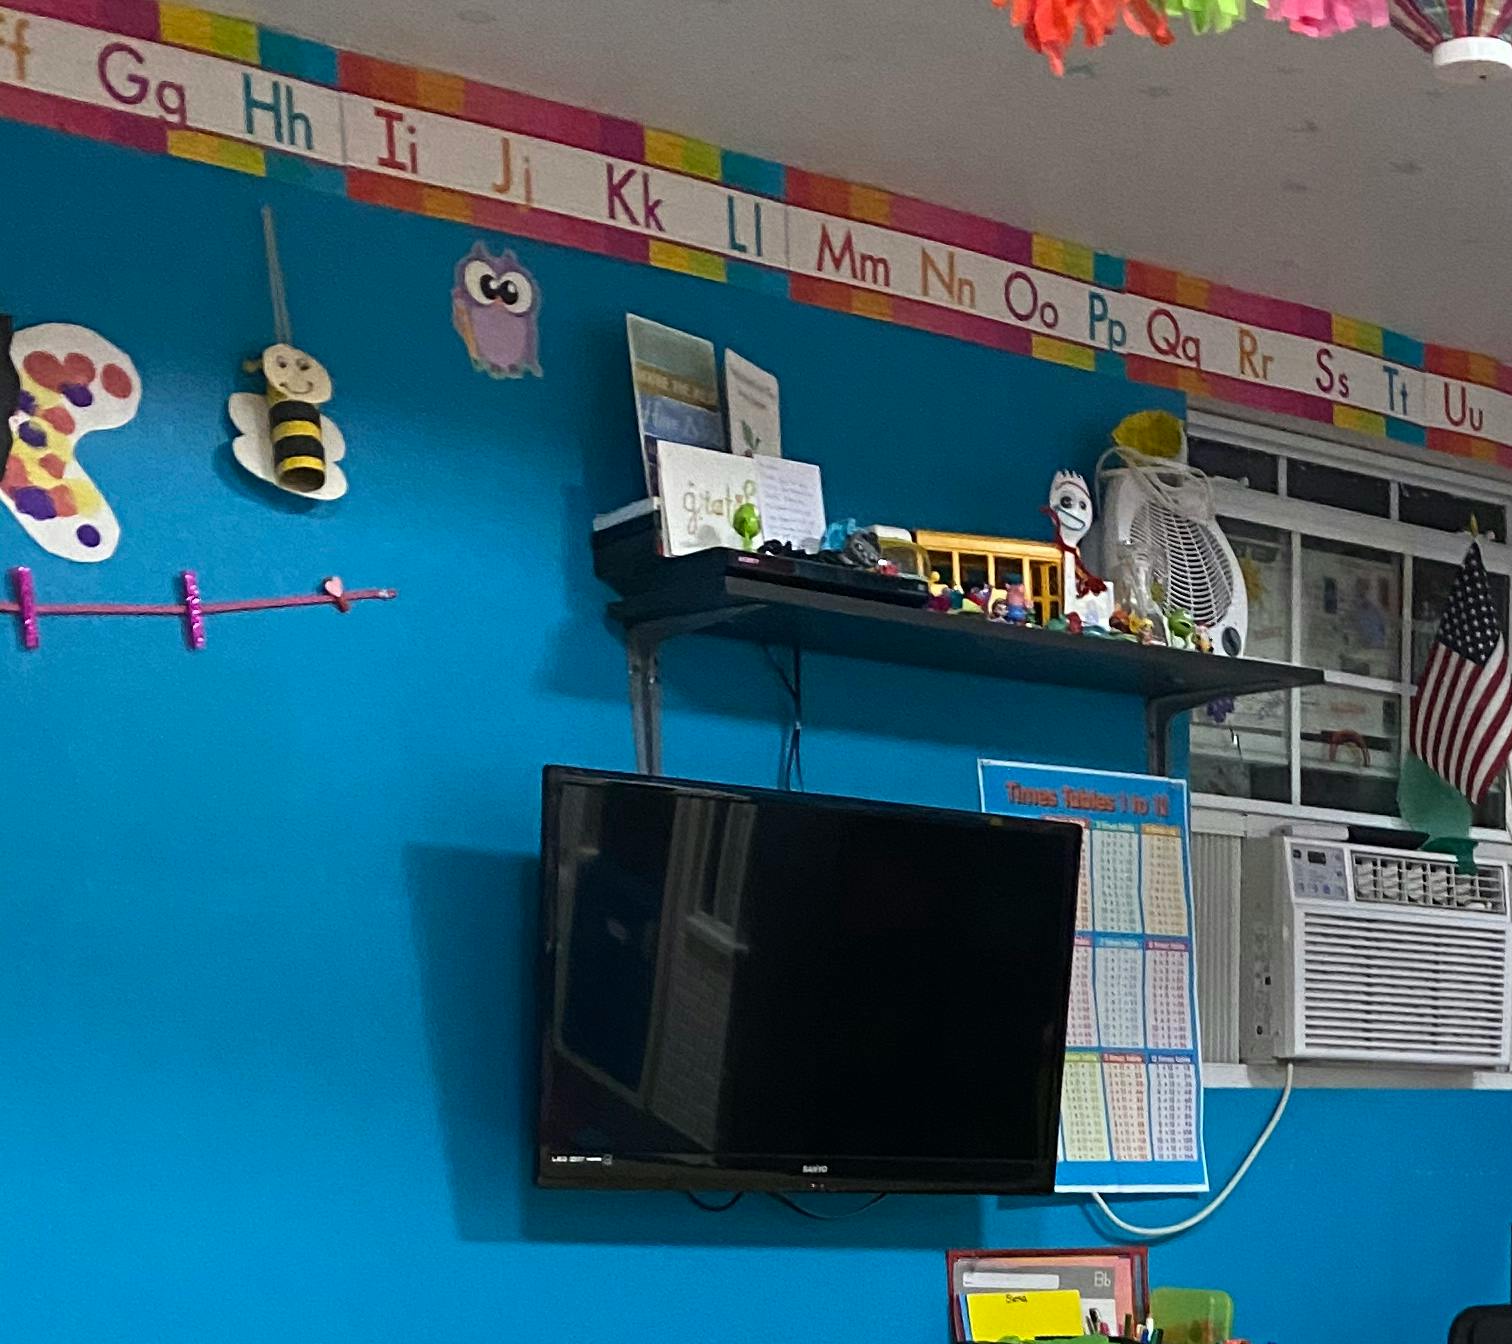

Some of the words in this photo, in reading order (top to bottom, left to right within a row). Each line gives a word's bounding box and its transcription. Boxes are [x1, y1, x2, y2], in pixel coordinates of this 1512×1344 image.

[97, 41, 189, 127] Gg
[241, 72, 314, 152] Hh
[374, 107, 419, 175] Ii
[491, 137, 535, 208] Jj
[606, 163, 667, 233] Kk
[726, 194, 764, 259] Ll
[815, 222, 891, 288] Mm
[919, 247, 976, 310] Nn
[1002, 270, 1059, 330] Oo
[1087, 290, 1127, 350] Pp
[1145, 308, 1201, 376] Qq
[1237, 327, 1274, 381] Rr
[1314, 347, 1351, 399] Ss
[1381, 366, 1409, 416] Tt
[1442, 382, 1484, 432] Uu
[1006, 781, 1058, 808] Times
[1063, 785, 1117, 813] Tables
[1133, 794, 1150, 816] to
[1093, 1271, 1111, 1287] Bb
